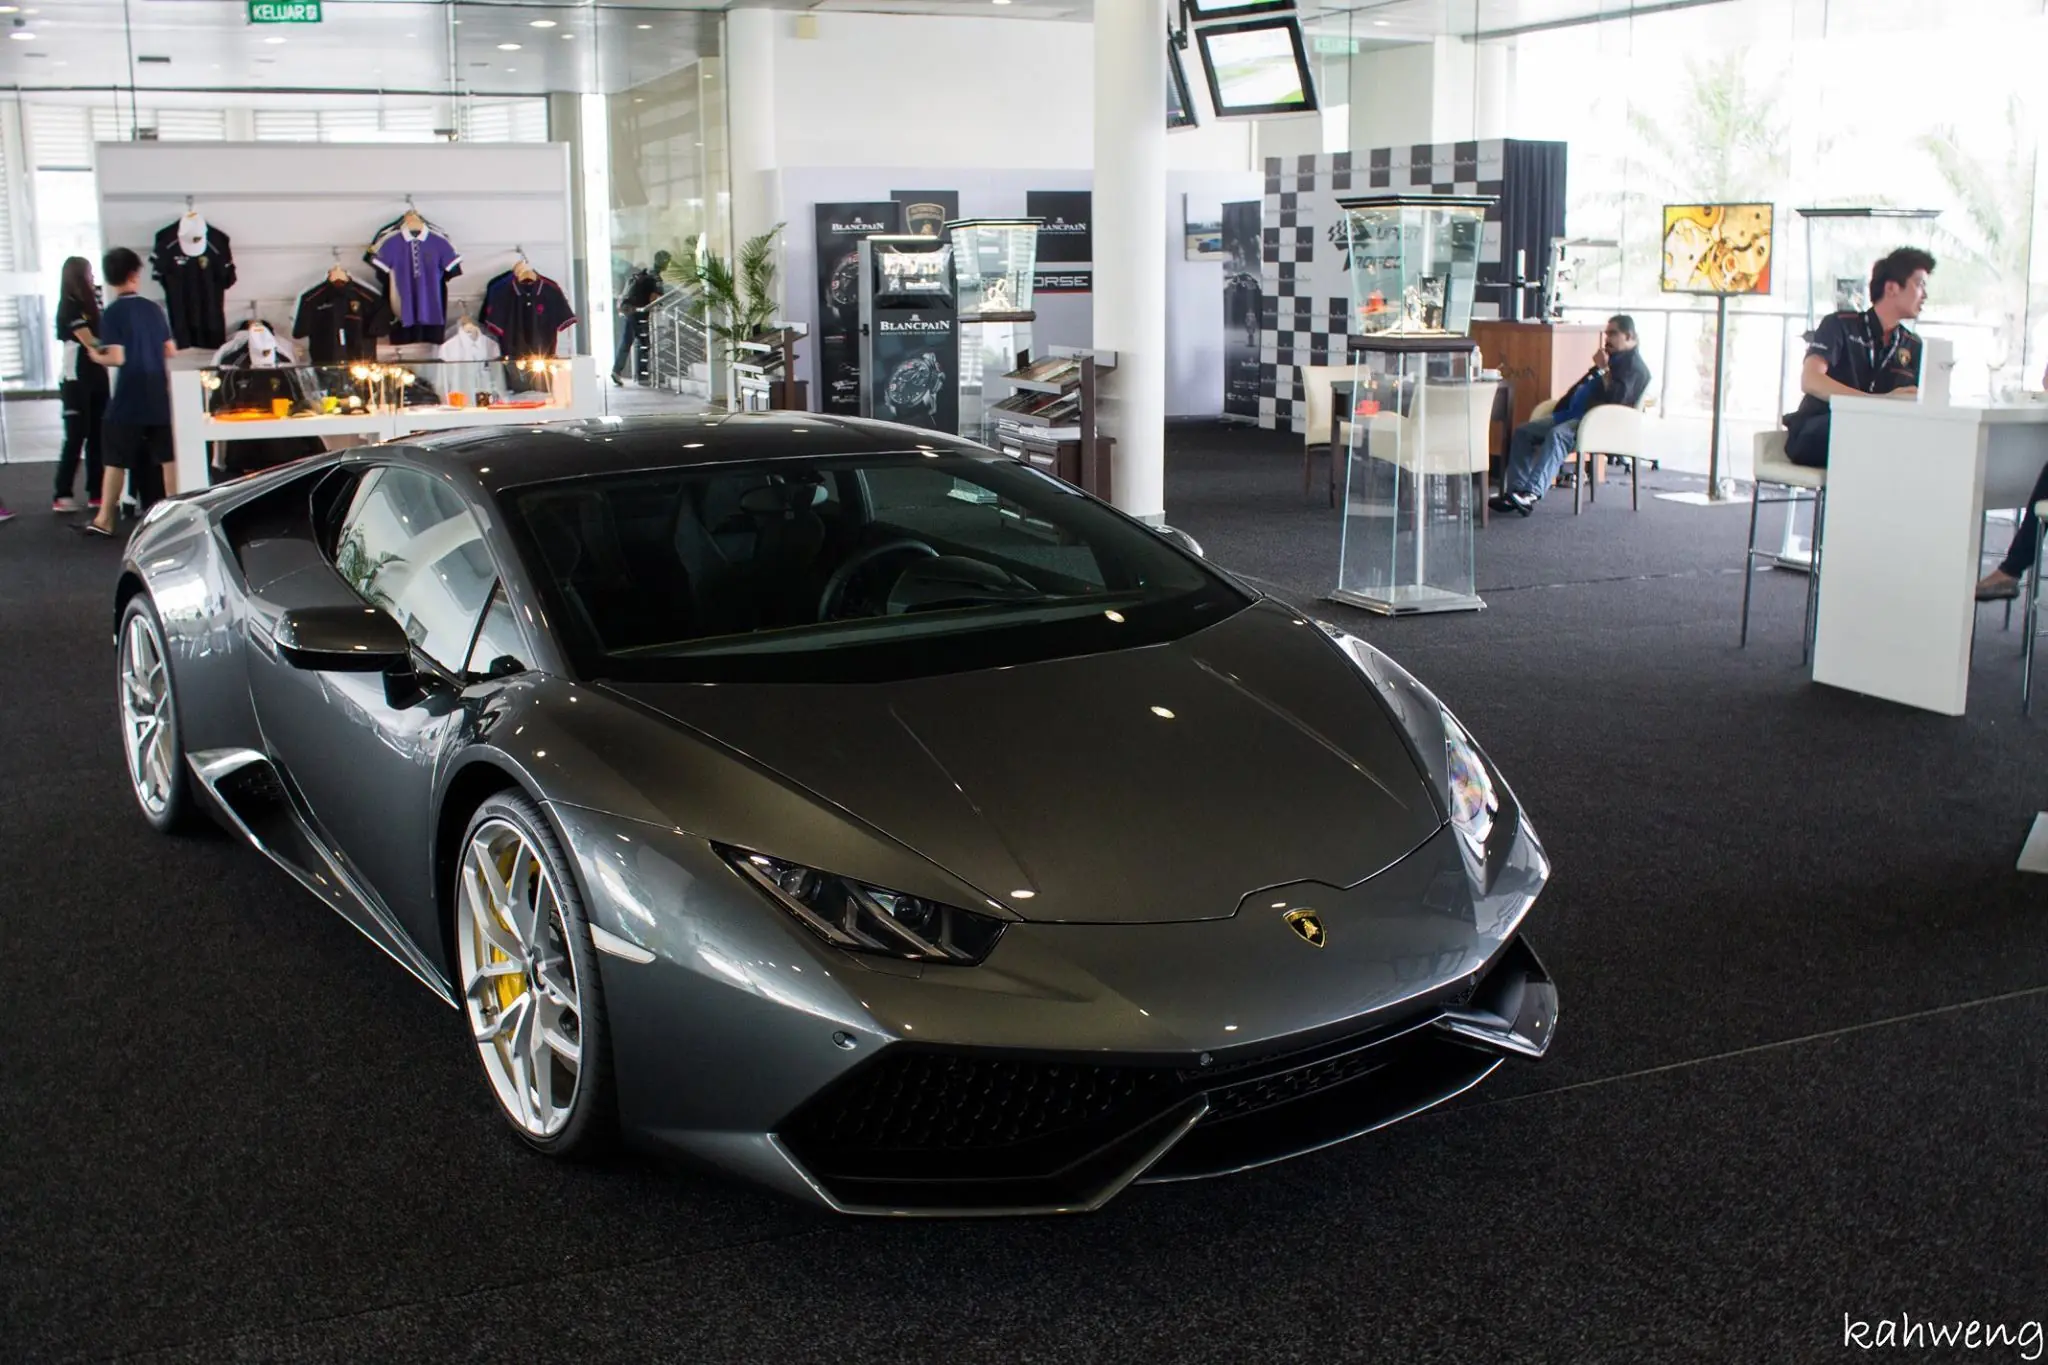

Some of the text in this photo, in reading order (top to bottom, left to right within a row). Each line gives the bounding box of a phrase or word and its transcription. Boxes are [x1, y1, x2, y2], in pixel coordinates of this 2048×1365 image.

[252, 4, 305, 20] KELUAR
[831, 222, 885, 231] BLANCPAIN
[1033, 275, 1089, 287] ORSE
[880, 320, 951, 331] BLANCPAIN
